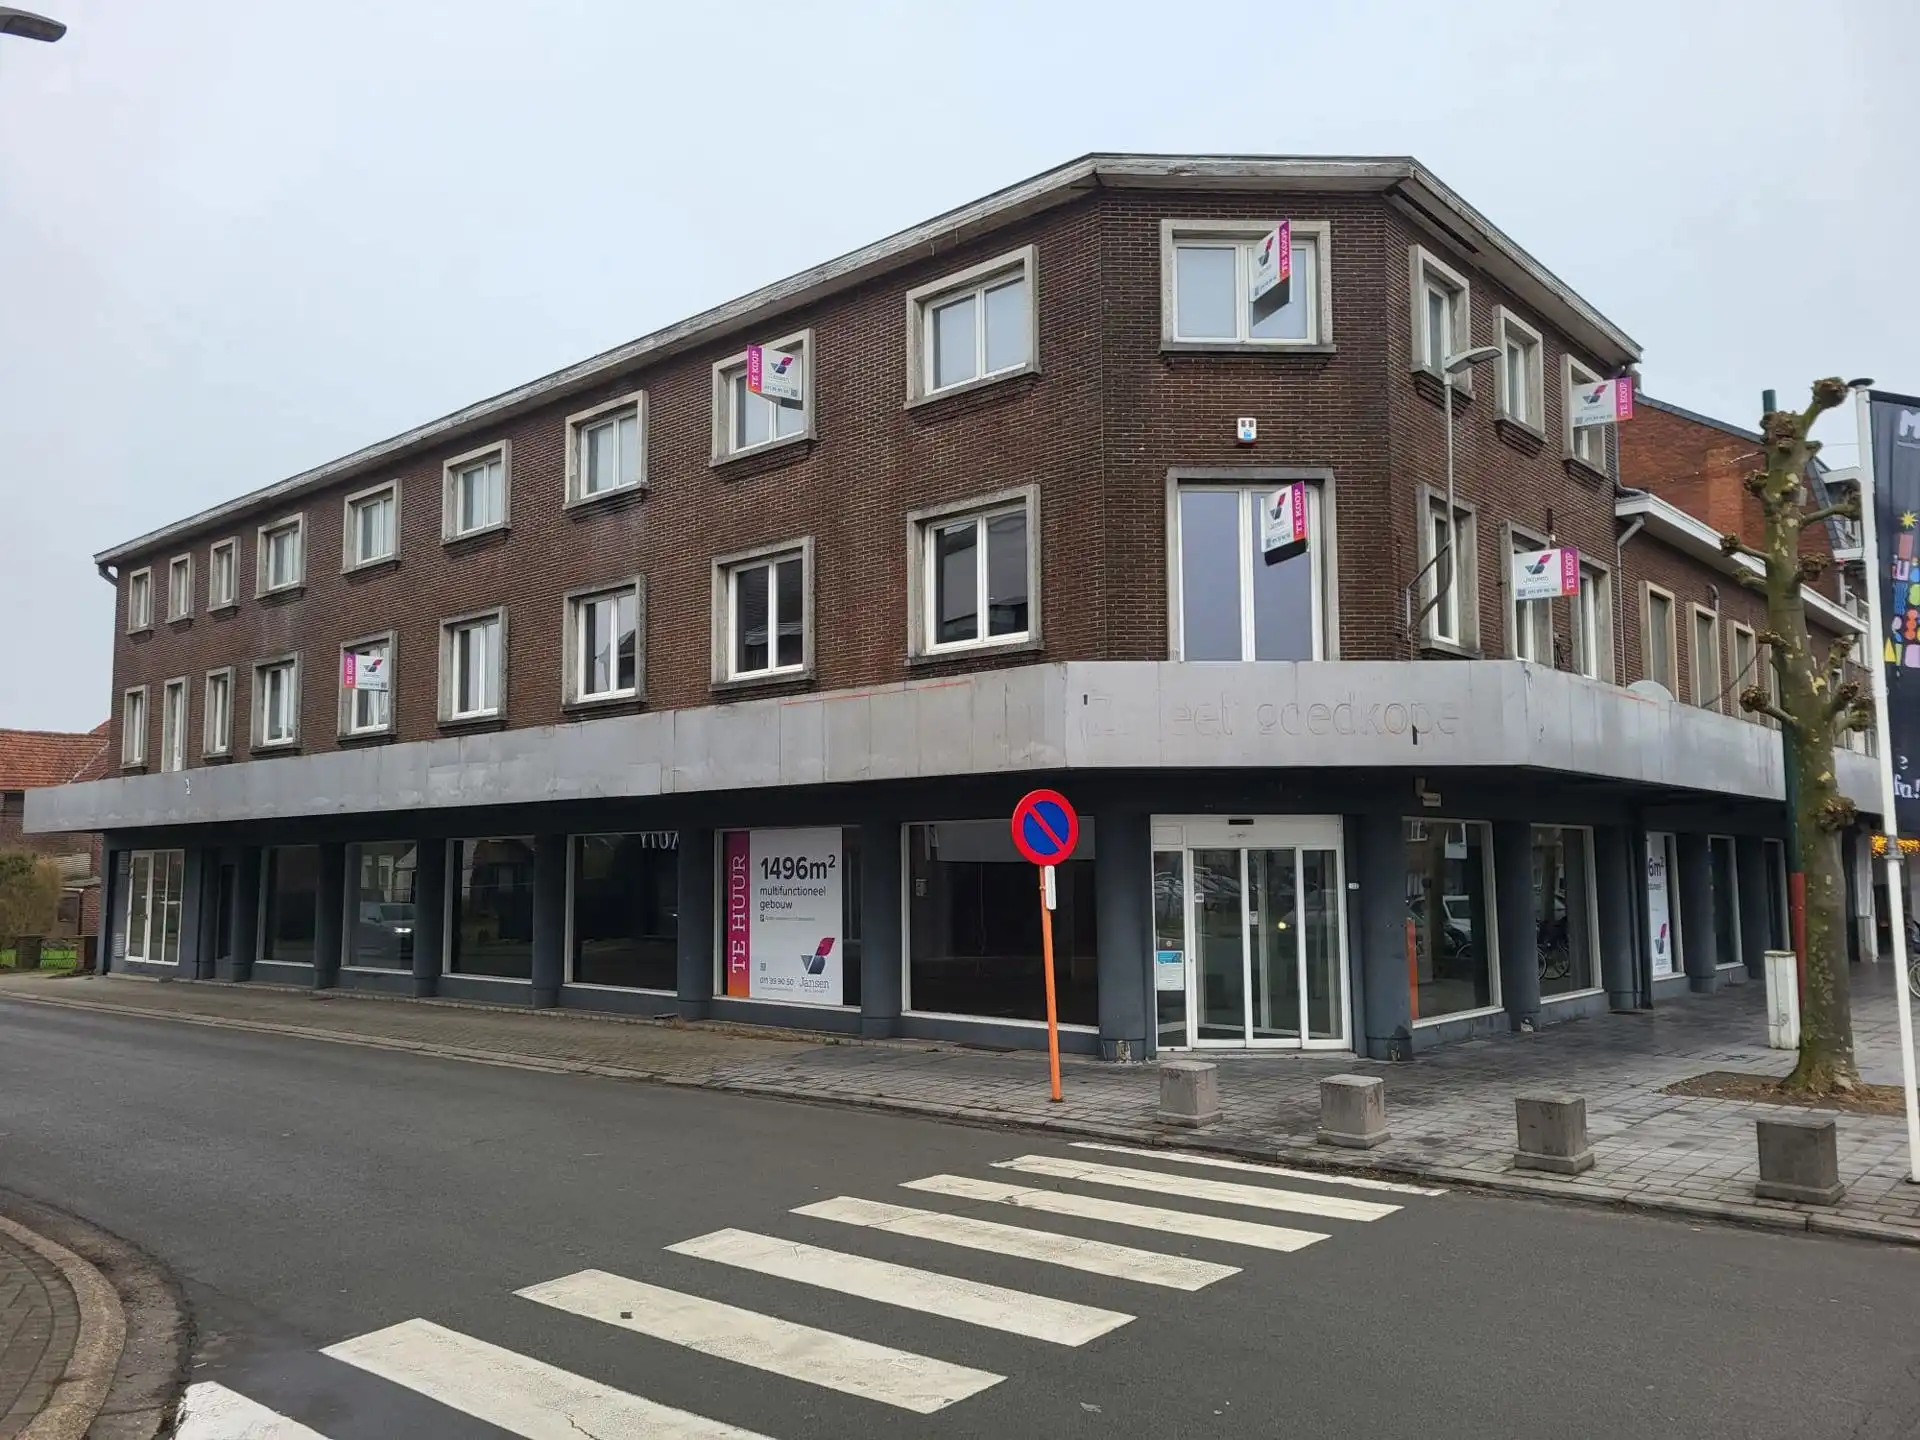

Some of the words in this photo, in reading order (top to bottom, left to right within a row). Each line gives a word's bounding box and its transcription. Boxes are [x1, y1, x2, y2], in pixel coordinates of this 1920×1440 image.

[1294, 488, 1302, 517] KOOP
[732, 854, 746, 932] HUUR
[759, 885, 826, 897] multifunctioneel
[759, 899, 793, 911] gebouw
[732, 940, 746, 974] TE
[799, 976, 830, 989] Jansen
